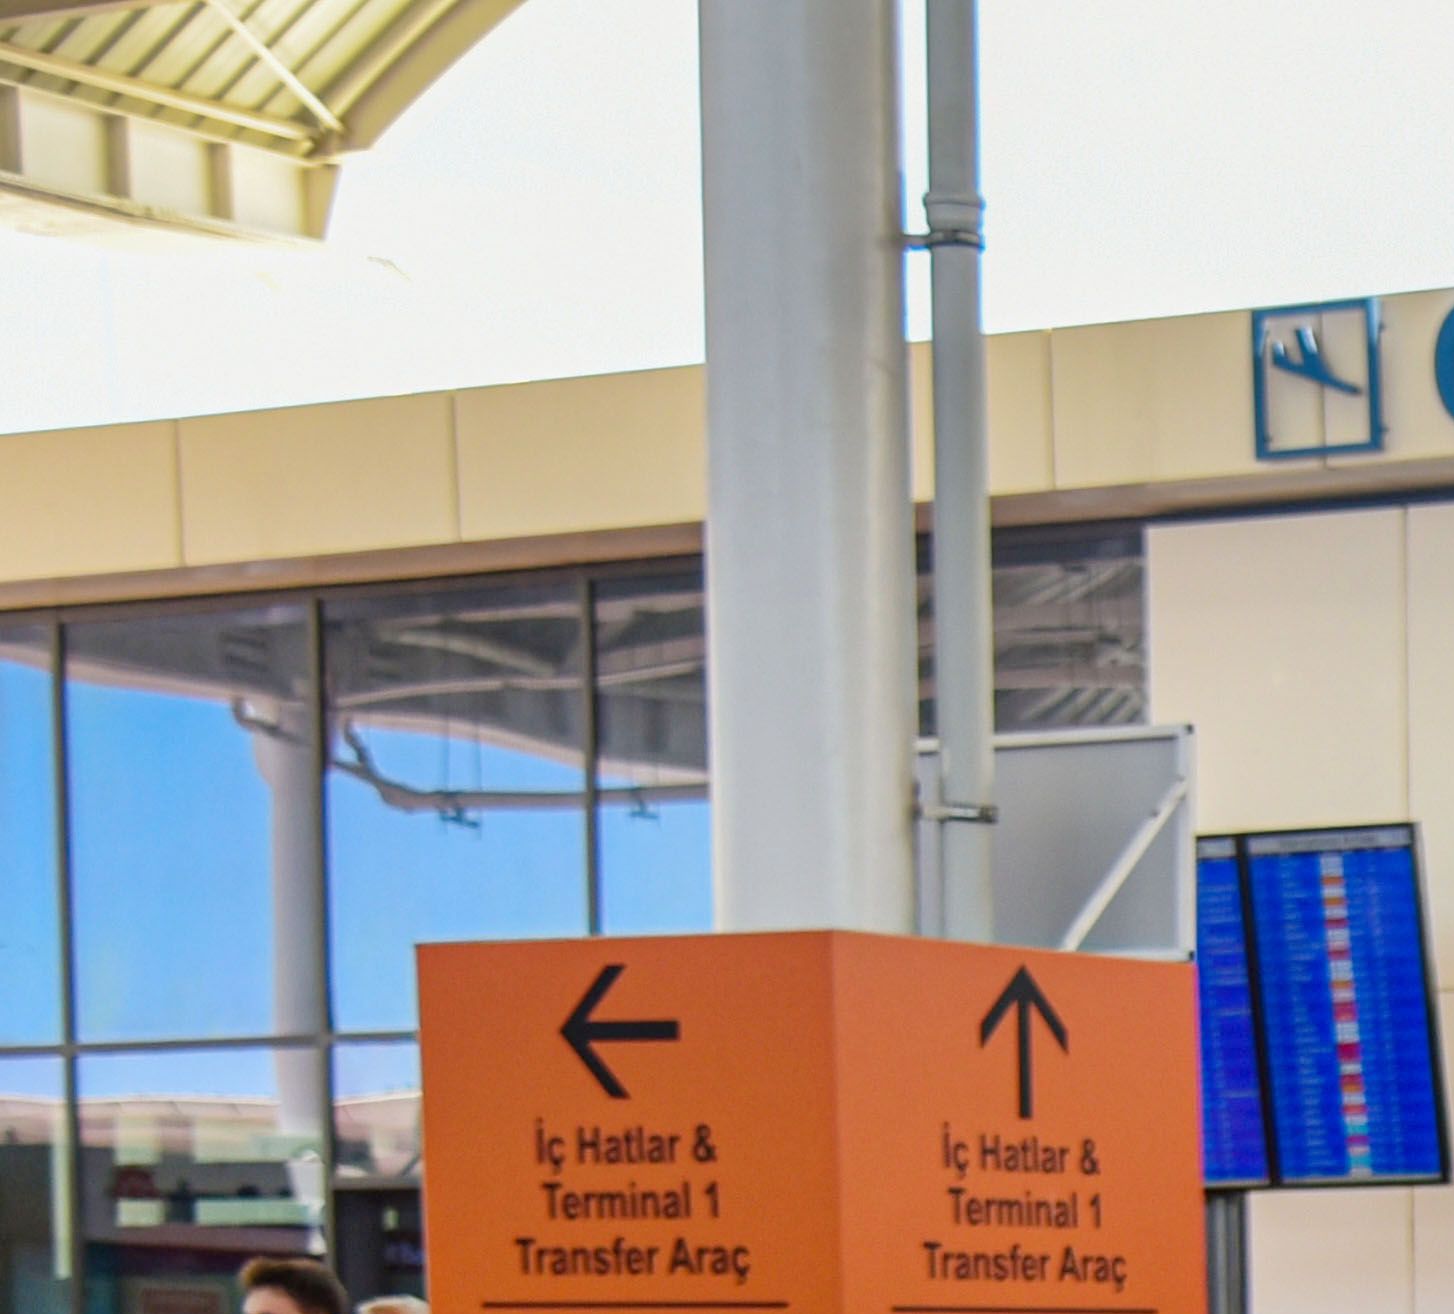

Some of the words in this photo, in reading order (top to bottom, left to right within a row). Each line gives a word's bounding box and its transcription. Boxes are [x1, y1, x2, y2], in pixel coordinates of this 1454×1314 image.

[535, 1119, 565, 1175] İç
[577, 1126, 680, 1164] Hatlar
[692, 1123, 718, 1163] &
[942, 1122, 969, 1179] İç
[979, 1134, 1069, 1173] Hatlar
[1080, 1139, 1101, 1176] &
[541, 1182, 691, 1219] Terminal
[704, 1182, 721, 1218] 1
[948, 1187, 1078, 1229] Terminal
[1089, 1194, 1102, 1229] 1
[515, 1237, 660, 1275] Transfer
[668, 1237, 751, 1286] Araç
[923, 1241, 1050, 1282] Transfer
[1058, 1246, 1127, 1294] Araç
